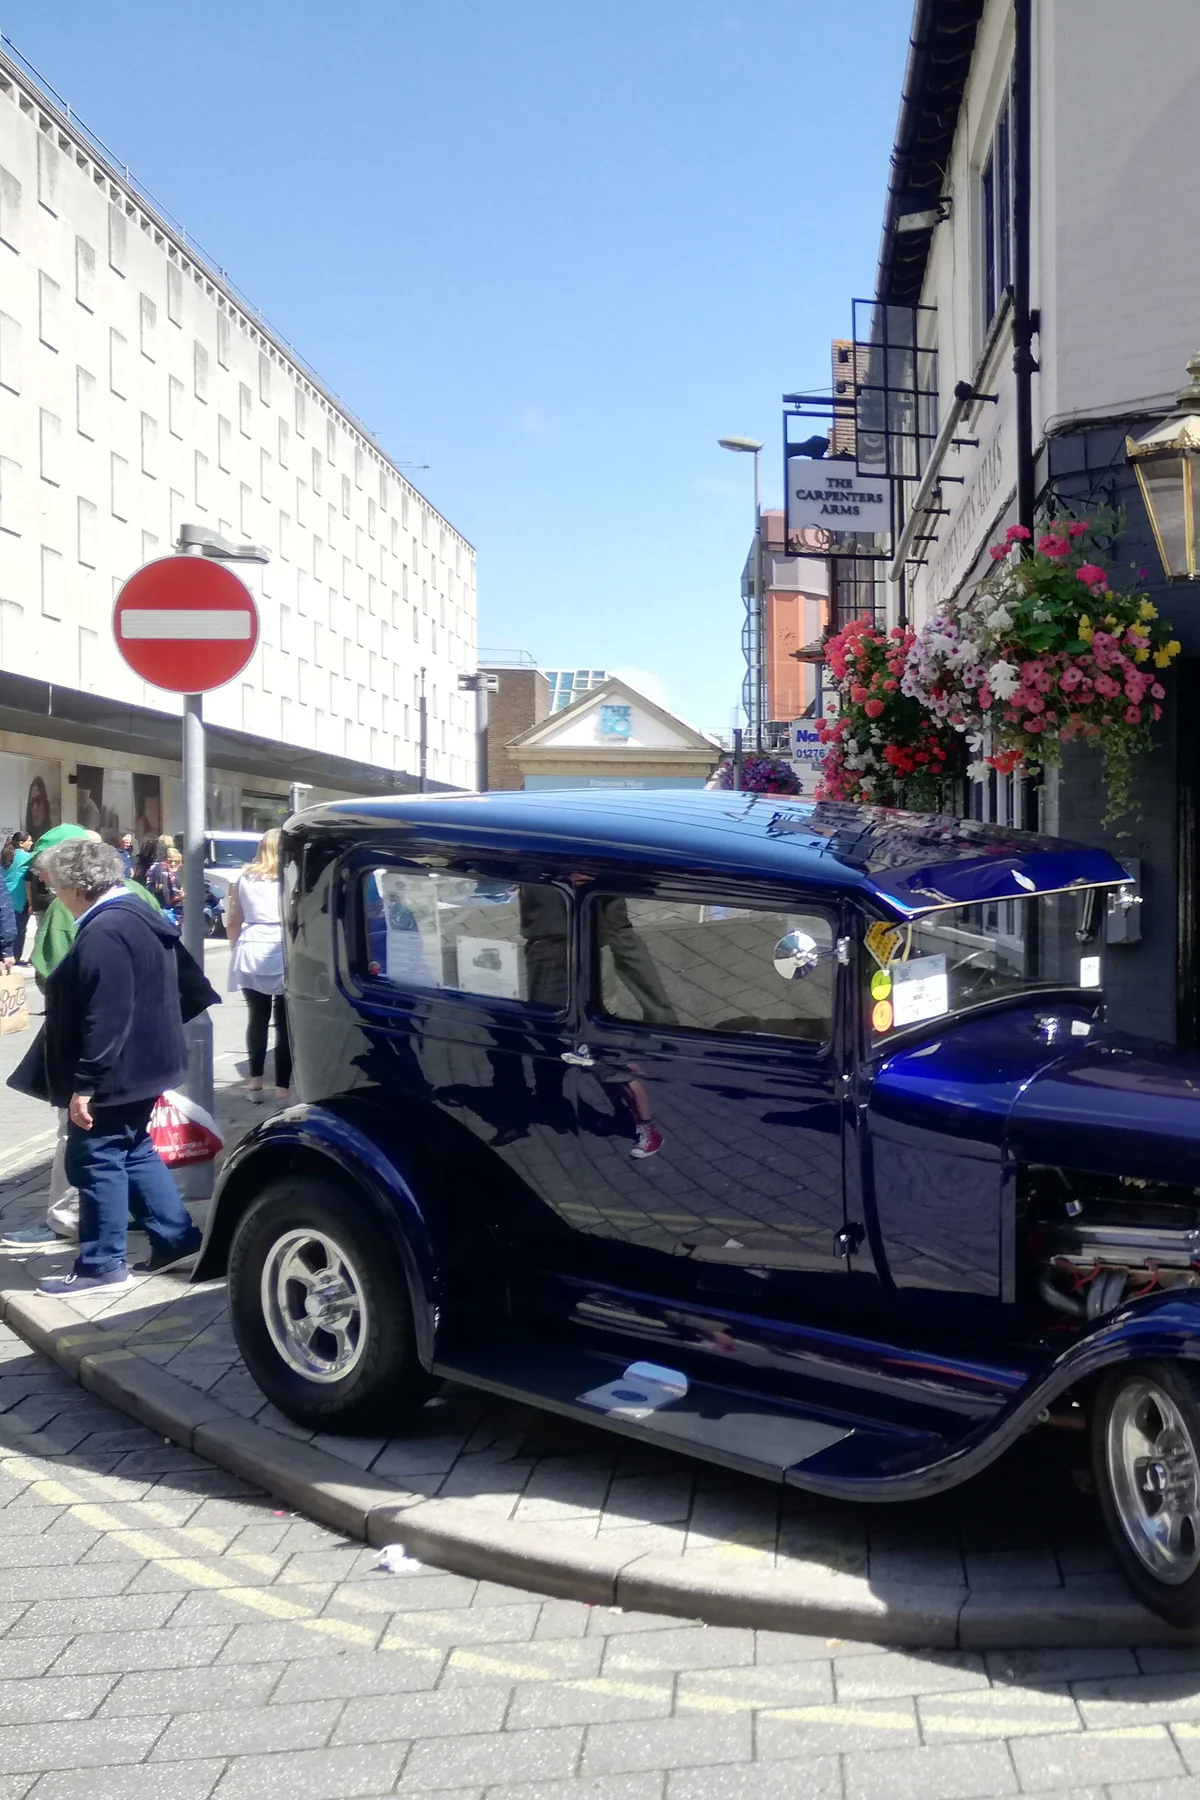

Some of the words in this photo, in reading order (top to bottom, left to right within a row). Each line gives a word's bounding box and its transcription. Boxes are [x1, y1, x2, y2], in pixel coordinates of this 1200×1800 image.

[826, 477, 853, 489] THE
[796, 489, 883, 504] CARPENTERS
[820, 504, 861, 516] ARMS
